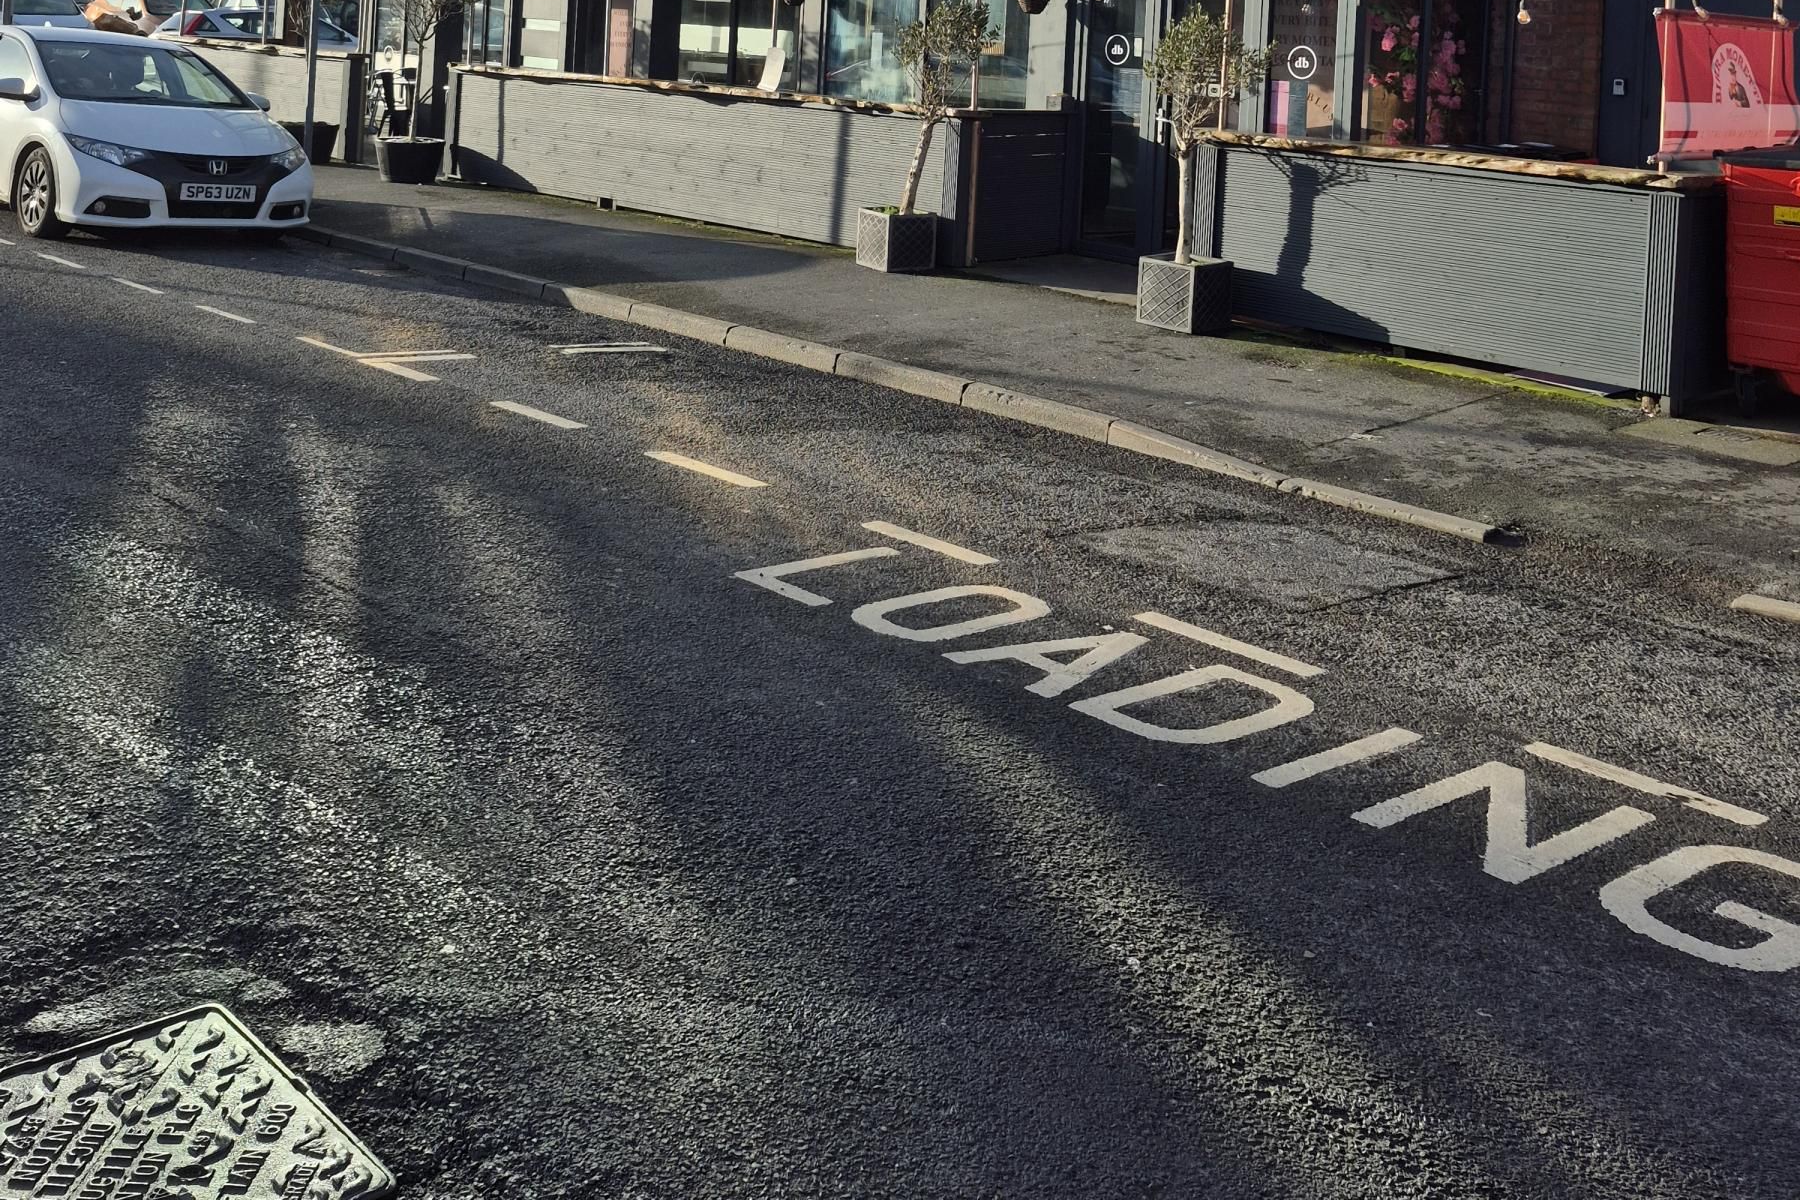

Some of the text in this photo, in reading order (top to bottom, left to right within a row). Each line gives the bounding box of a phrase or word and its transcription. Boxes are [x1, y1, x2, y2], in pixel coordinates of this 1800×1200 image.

[1111, 44, 1124, 55] db
[1294, 56, 1310, 69] db
[186, 185, 251, 200] SP63 UZN
[733, 546, 1800, 974] LOADING
[256, 1103, 296, 1135] 600
[13, 1098, 98, 1181] STANTON
